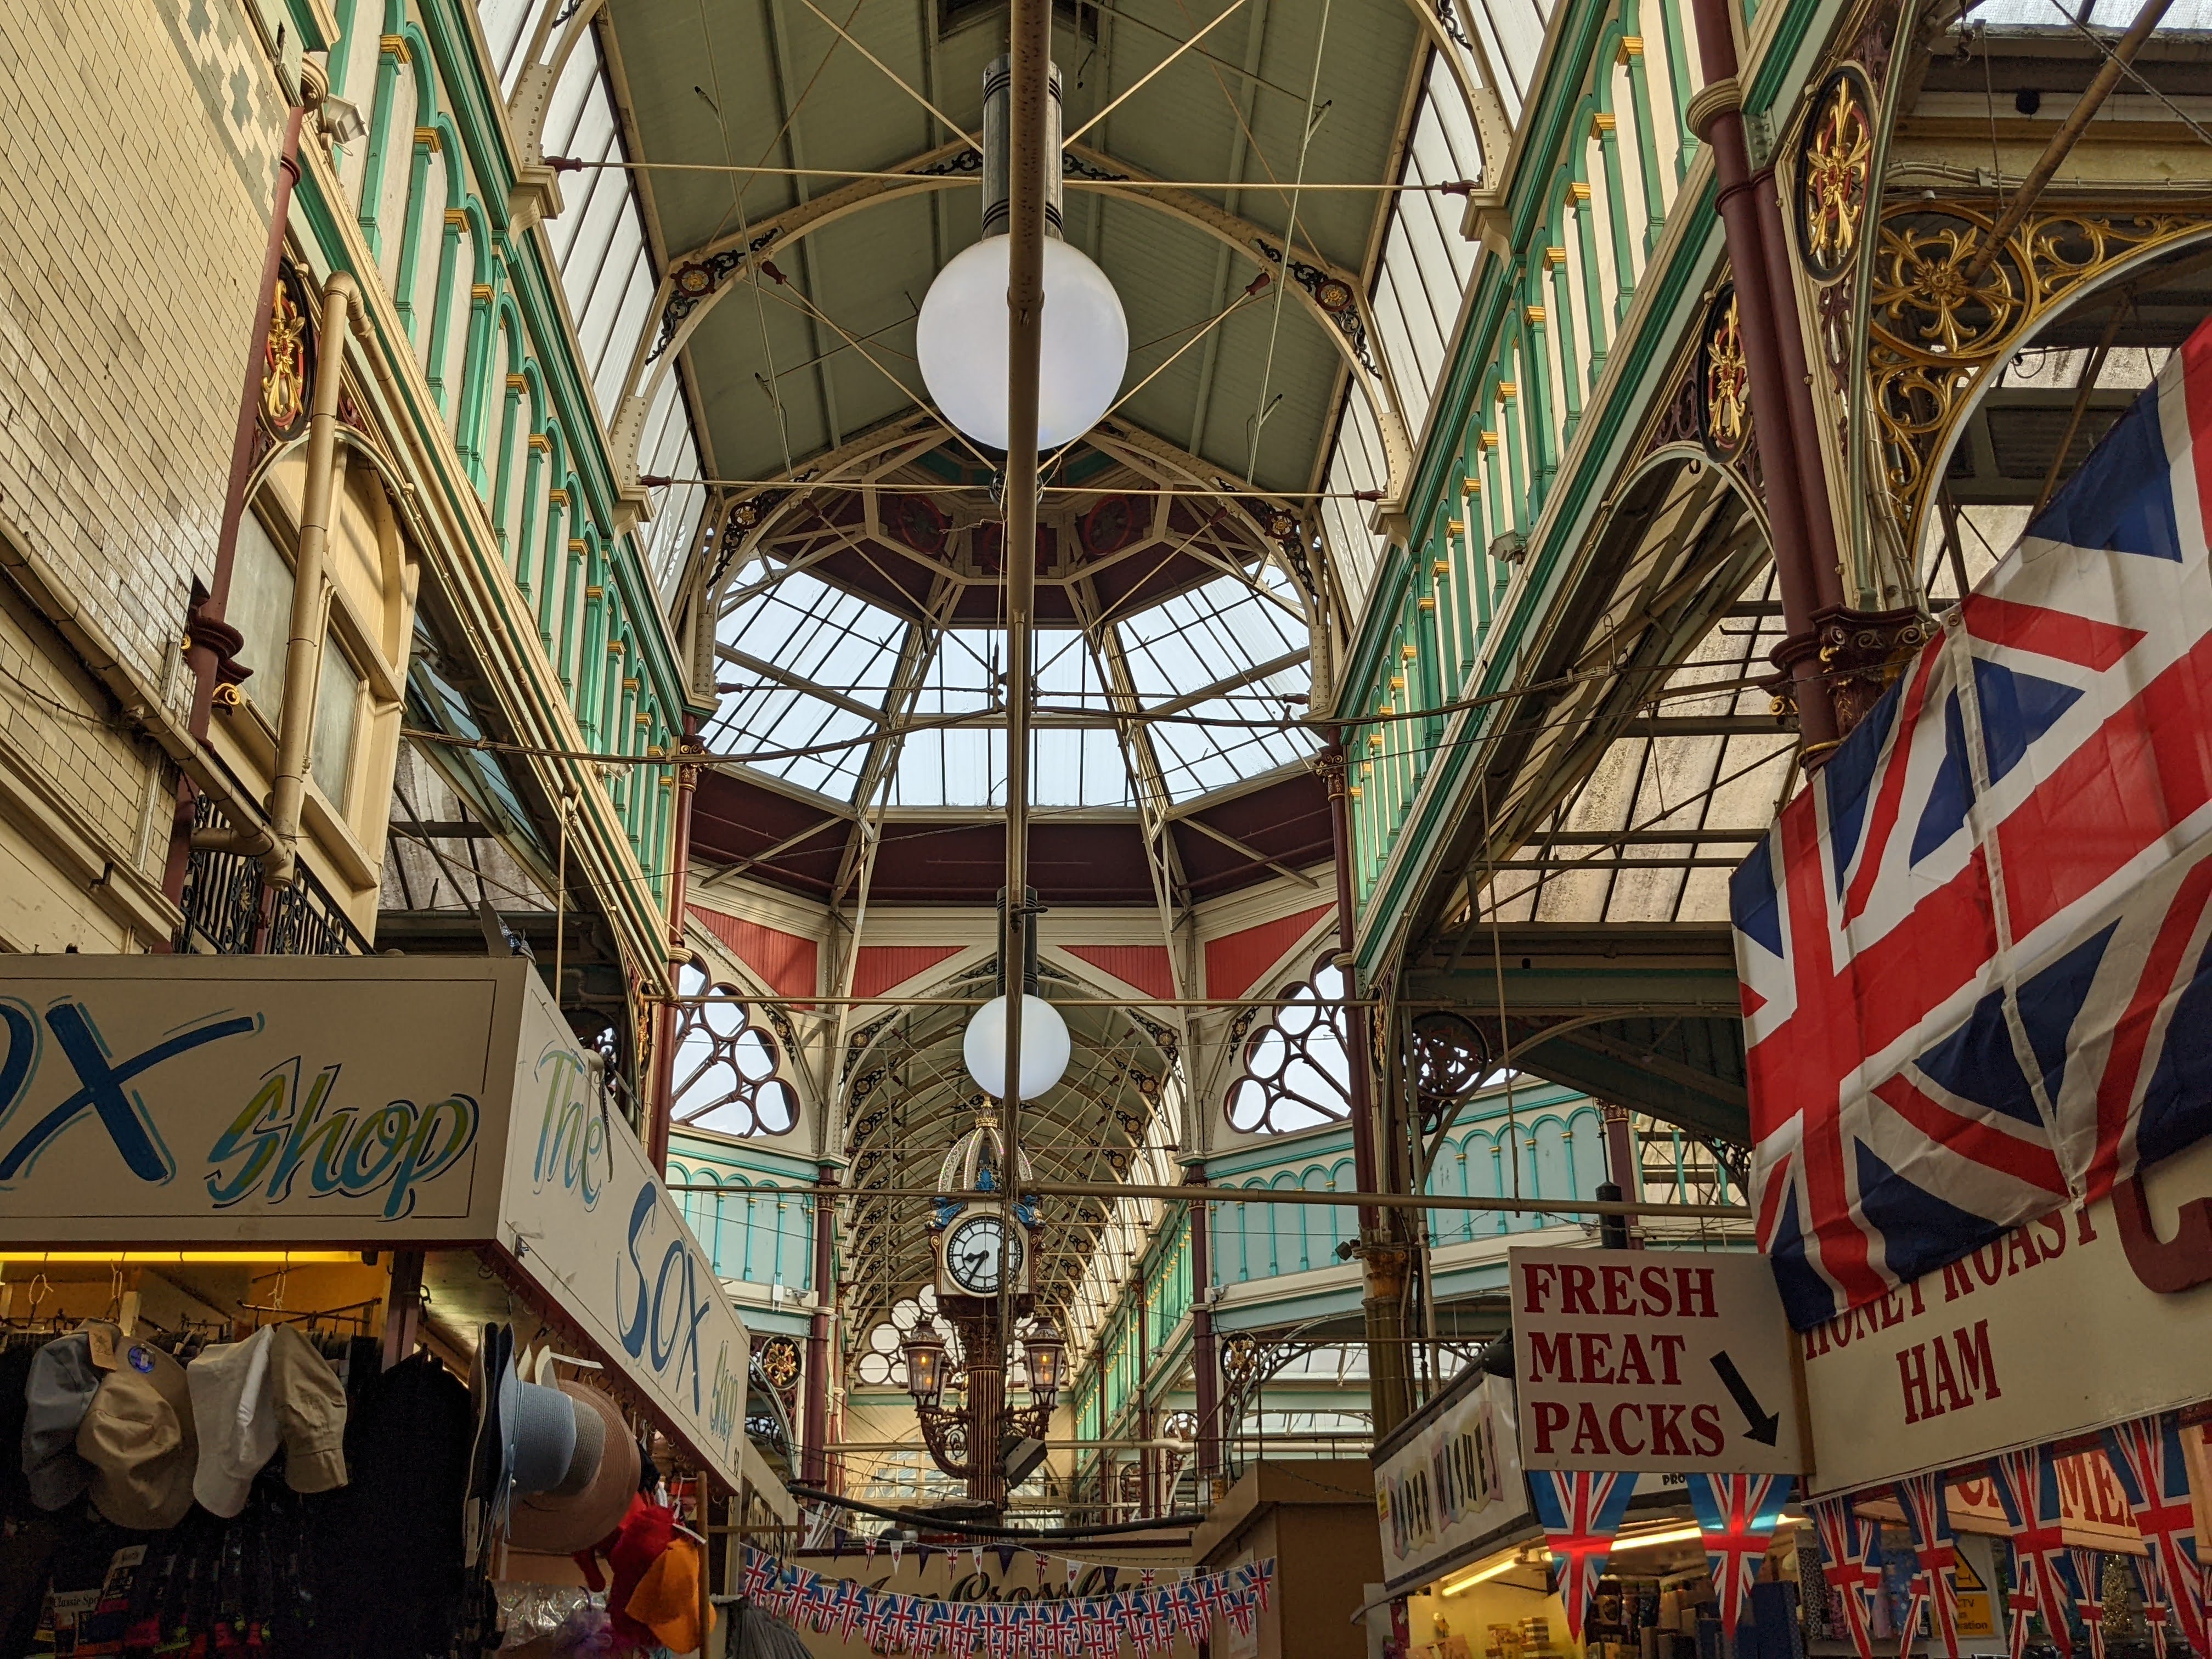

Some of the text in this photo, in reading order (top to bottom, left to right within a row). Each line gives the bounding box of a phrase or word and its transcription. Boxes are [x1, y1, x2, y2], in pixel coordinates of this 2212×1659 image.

[205, 1059, 477, 1221] Shop
[534, 1043, 603, 1211] The
[710, 1341, 738, 1467] Shop
[1521, 1263, 1719, 1318] FRESH
[1528, 1332, 1685, 1385] MEAT
[1896, 1318, 2001, 1425] HAM
[1531, 1402, 1724, 1457] PACKS
[1390, 1470, 1432, 1548] PAPER
[1434, 1417, 1497, 1519] WISHES
[2057, 1449, 2136, 1528] ME
